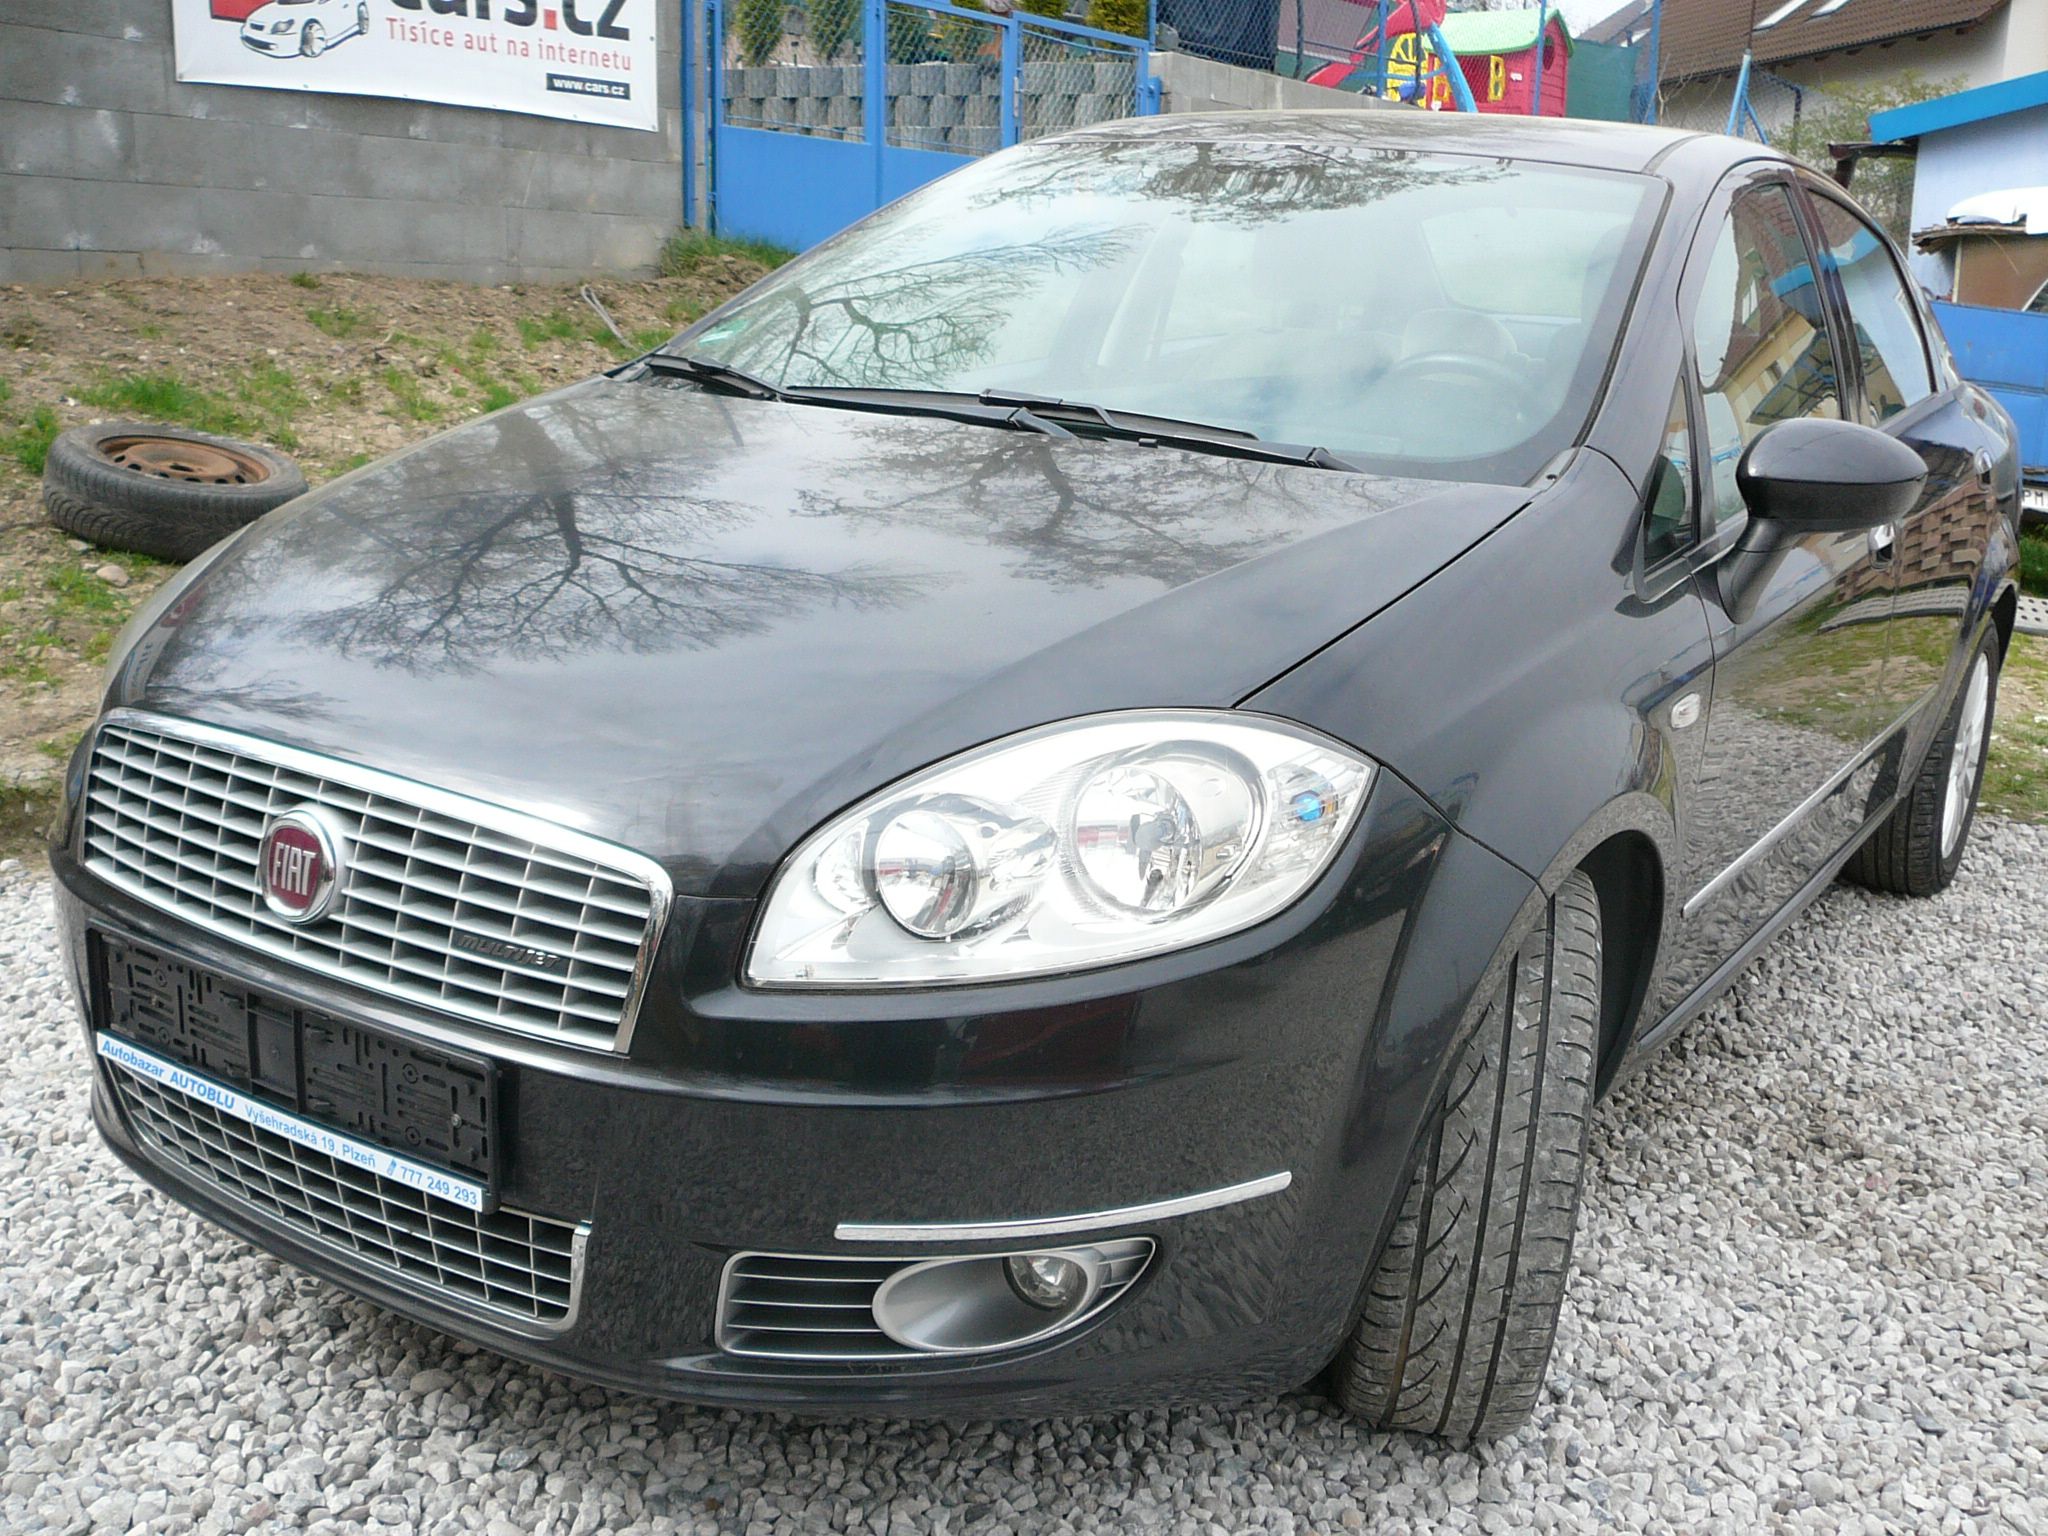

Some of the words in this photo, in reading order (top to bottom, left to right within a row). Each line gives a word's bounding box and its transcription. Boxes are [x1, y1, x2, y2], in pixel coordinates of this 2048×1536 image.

[386, 17, 454, 47] Tisíce
[464, 33, 497, 53] aut
[507, 39, 529, 57] na
[538, 38, 631, 70] internetu
[552, 78, 625, 95] www.cars.cz
[272, 841, 317, 896] FIAT
[102, 1040, 165, 1078] Autobazar
[170, 1071, 235, 1110] AUTOBLU
[245, 1104, 318, 1146] Vyšehradská
[342, 1143, 377, 1168] Plzeň
[401, 1166, 423, 1185] 777
[427, 1175, 451, 1196] 249
[454, 1185, 478, 1206] 293
